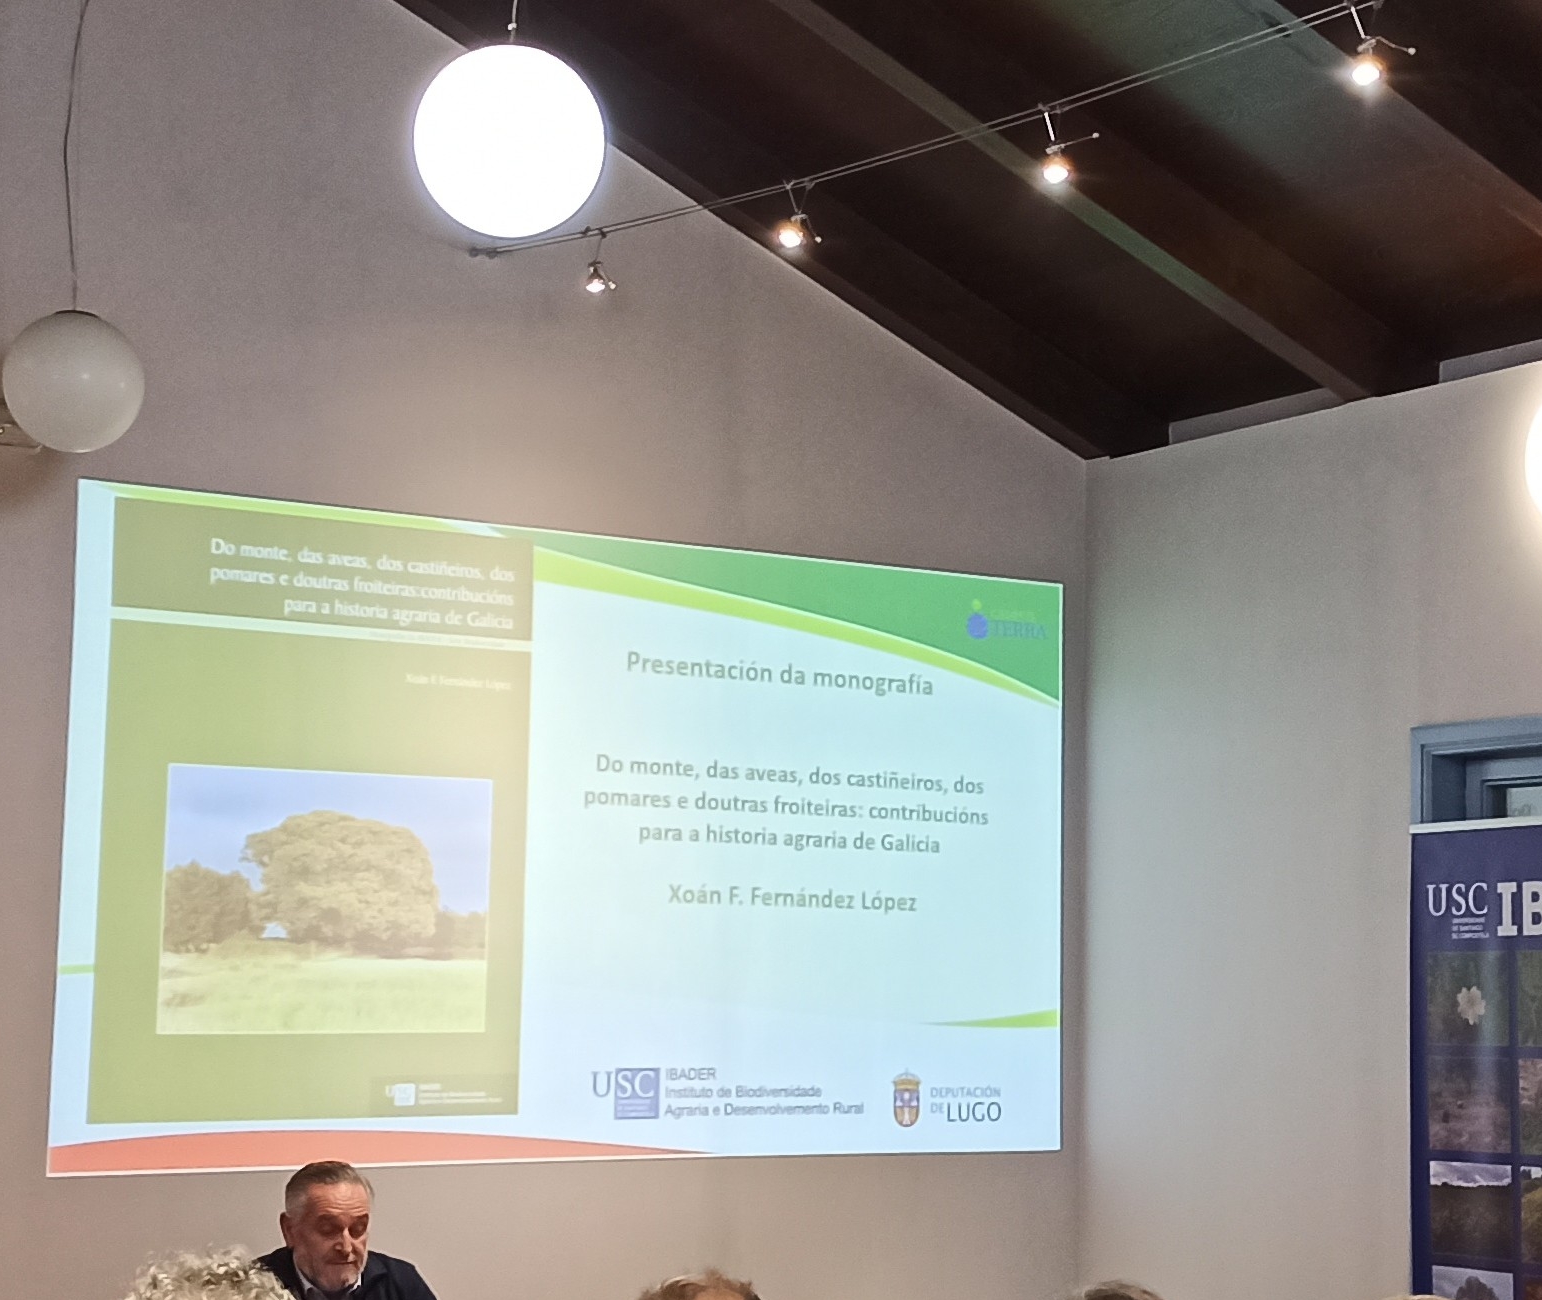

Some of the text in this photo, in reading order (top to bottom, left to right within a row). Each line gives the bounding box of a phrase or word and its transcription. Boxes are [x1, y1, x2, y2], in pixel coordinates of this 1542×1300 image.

[210, 537, 236, 556] Do
[239, 544, 292, 563] monte,
[297, 547, 324, 564] das
[328, 553, 371, 570] aveas,
[376, 555, 403, 572] dos
[490, 565, 516, 583] dos
[209, 566, 275, 585] pomares
[279, 572, 289, 586] e
[293, 571, 349, 592] doutras
[283, 597, 514, 631] para a historia agraria de Galicia
[626, 651, 934, 697] Presentación da monografía
[596, 753, 985, 795] Do monte, das aveas, dos castiñeiros, dos
[583, 789, 989, 826] pomares e doutras froiteiras: contribucións
[638, 824, 941, 854] para a historia agraria de Galicia
[668, 883, 918, 915] Xoán F. Fernández López
[1426, 882, 1489, 917] USC
[591, 1069, 656, 1098] USC
[665, 1067, 716, 1081] IBADER
[665, 1085, 822, 1099] Instituto de Biodiversidade
[930, 1085, 1001, 1098] DEPUTACIÓN
[664, 1103, 709, 1118] Agraria
[712, 1105, 720, 1116] e
[724, 1102, 830, 1116] Desenvolvemento
[833, 1102, 864, 1115] Rural
[930, 1101, 1001, 1122] DE LUGO
